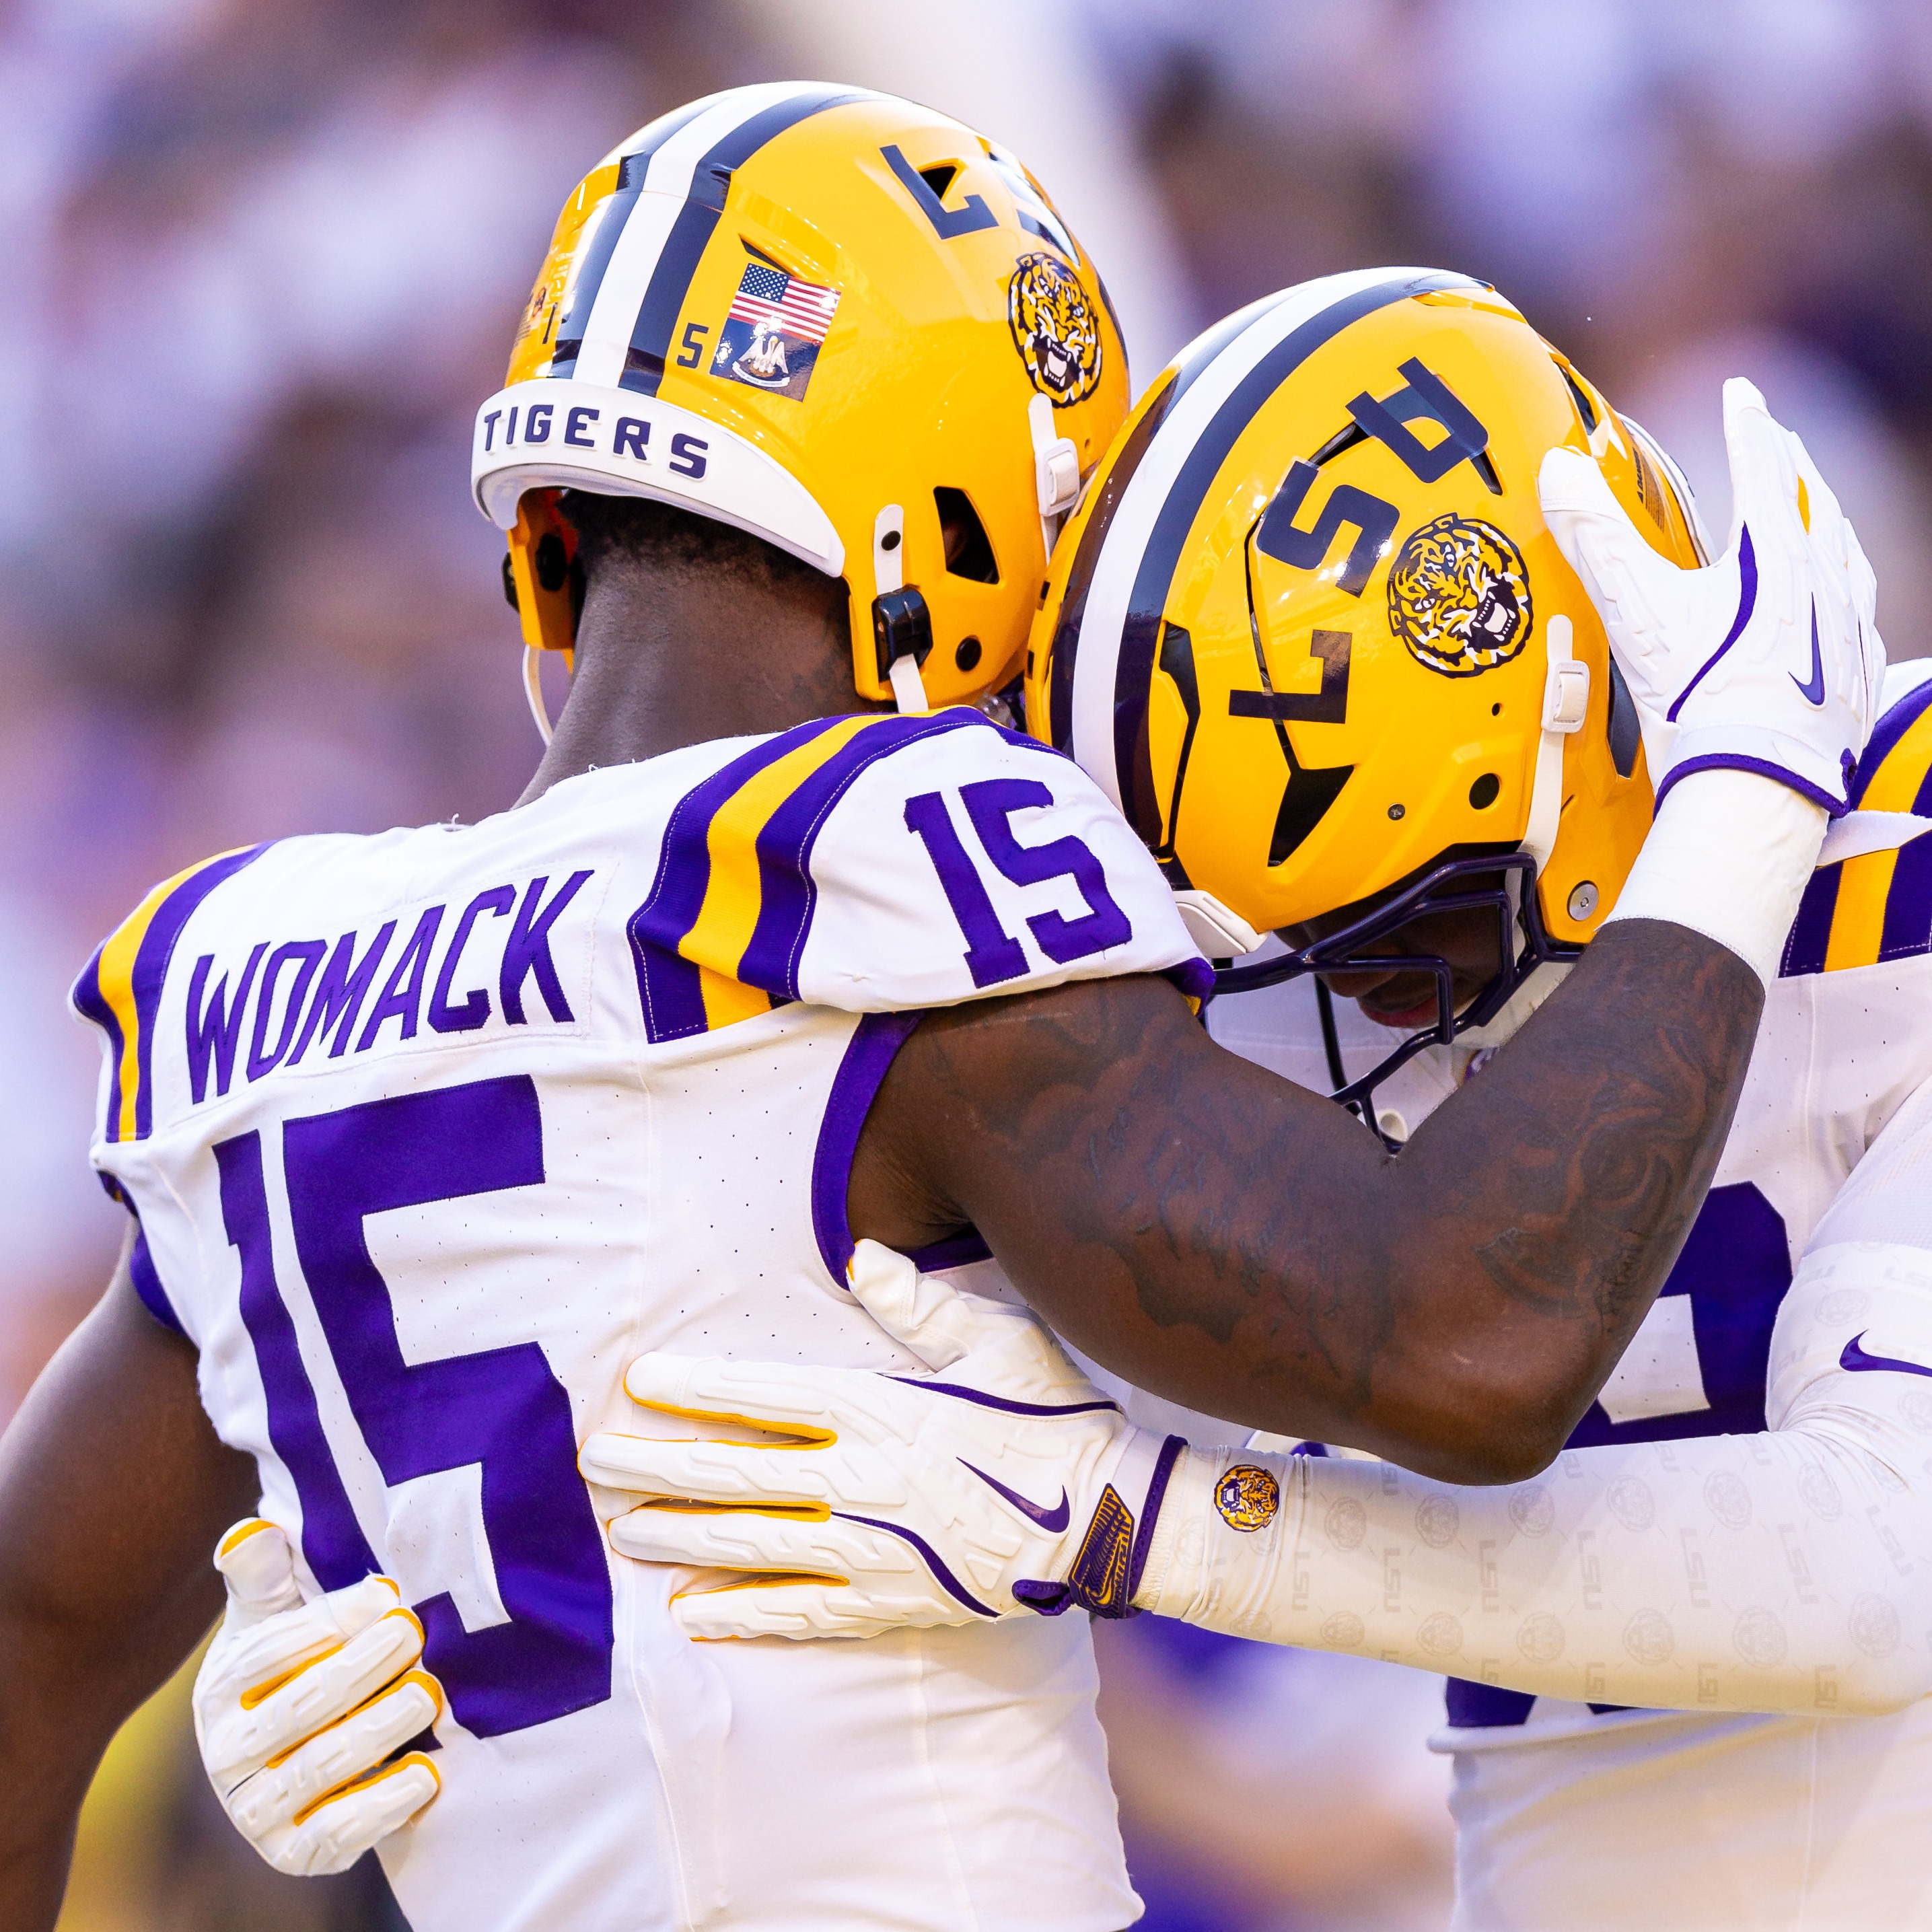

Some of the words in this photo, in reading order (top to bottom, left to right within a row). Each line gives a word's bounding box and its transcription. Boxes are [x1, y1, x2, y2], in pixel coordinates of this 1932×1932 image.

[676, 323, 709, 369] 5
[484, 404, 709, 480] TIGERS
[1229, 356, 1489, 724] LSU
[904, 778, 1133, 989] 15
[186, 869, 595, 1105] WOMACK
[213, 1074, 614, 1750] 15
[1291, 1551, 1311, 1612] LSU
[1383, 1548, 1402, 1613] LSU
[1479, 1539, 1500, 1612] LSU
[1577, 1530, 1603, 1611] LSU
[1680, 1528, 1711, 1609] LSU
[1776, 1522, 1820, 1604] LSU
